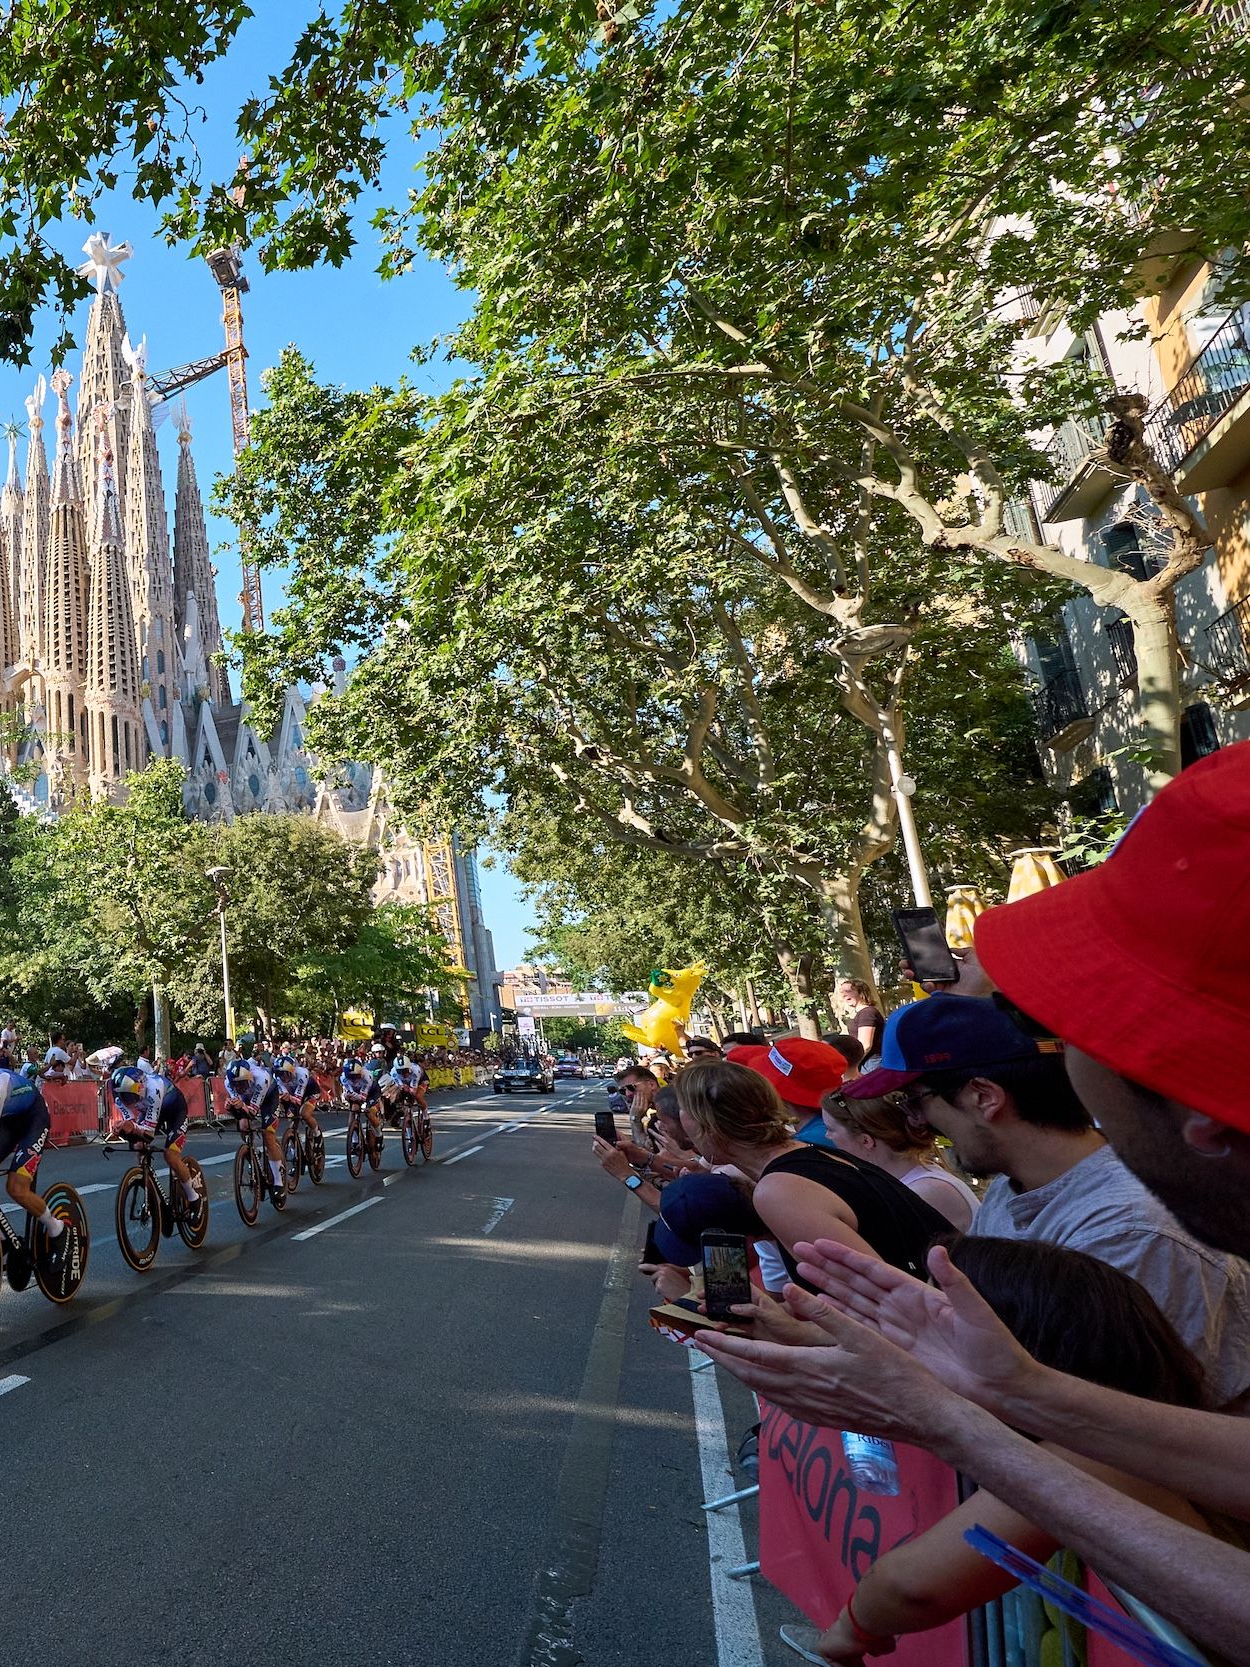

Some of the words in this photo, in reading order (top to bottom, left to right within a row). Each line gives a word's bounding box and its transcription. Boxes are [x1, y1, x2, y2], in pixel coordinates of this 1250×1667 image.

[534, 995, 569, 1003] TISSOT
[343, 1018, 371, 1027] LCL
[421, 1028, 444, 1036] LCL
[32, 1128, 49, 1154] BORA
[71, 1226, 81, 1281] OUTRIDE
